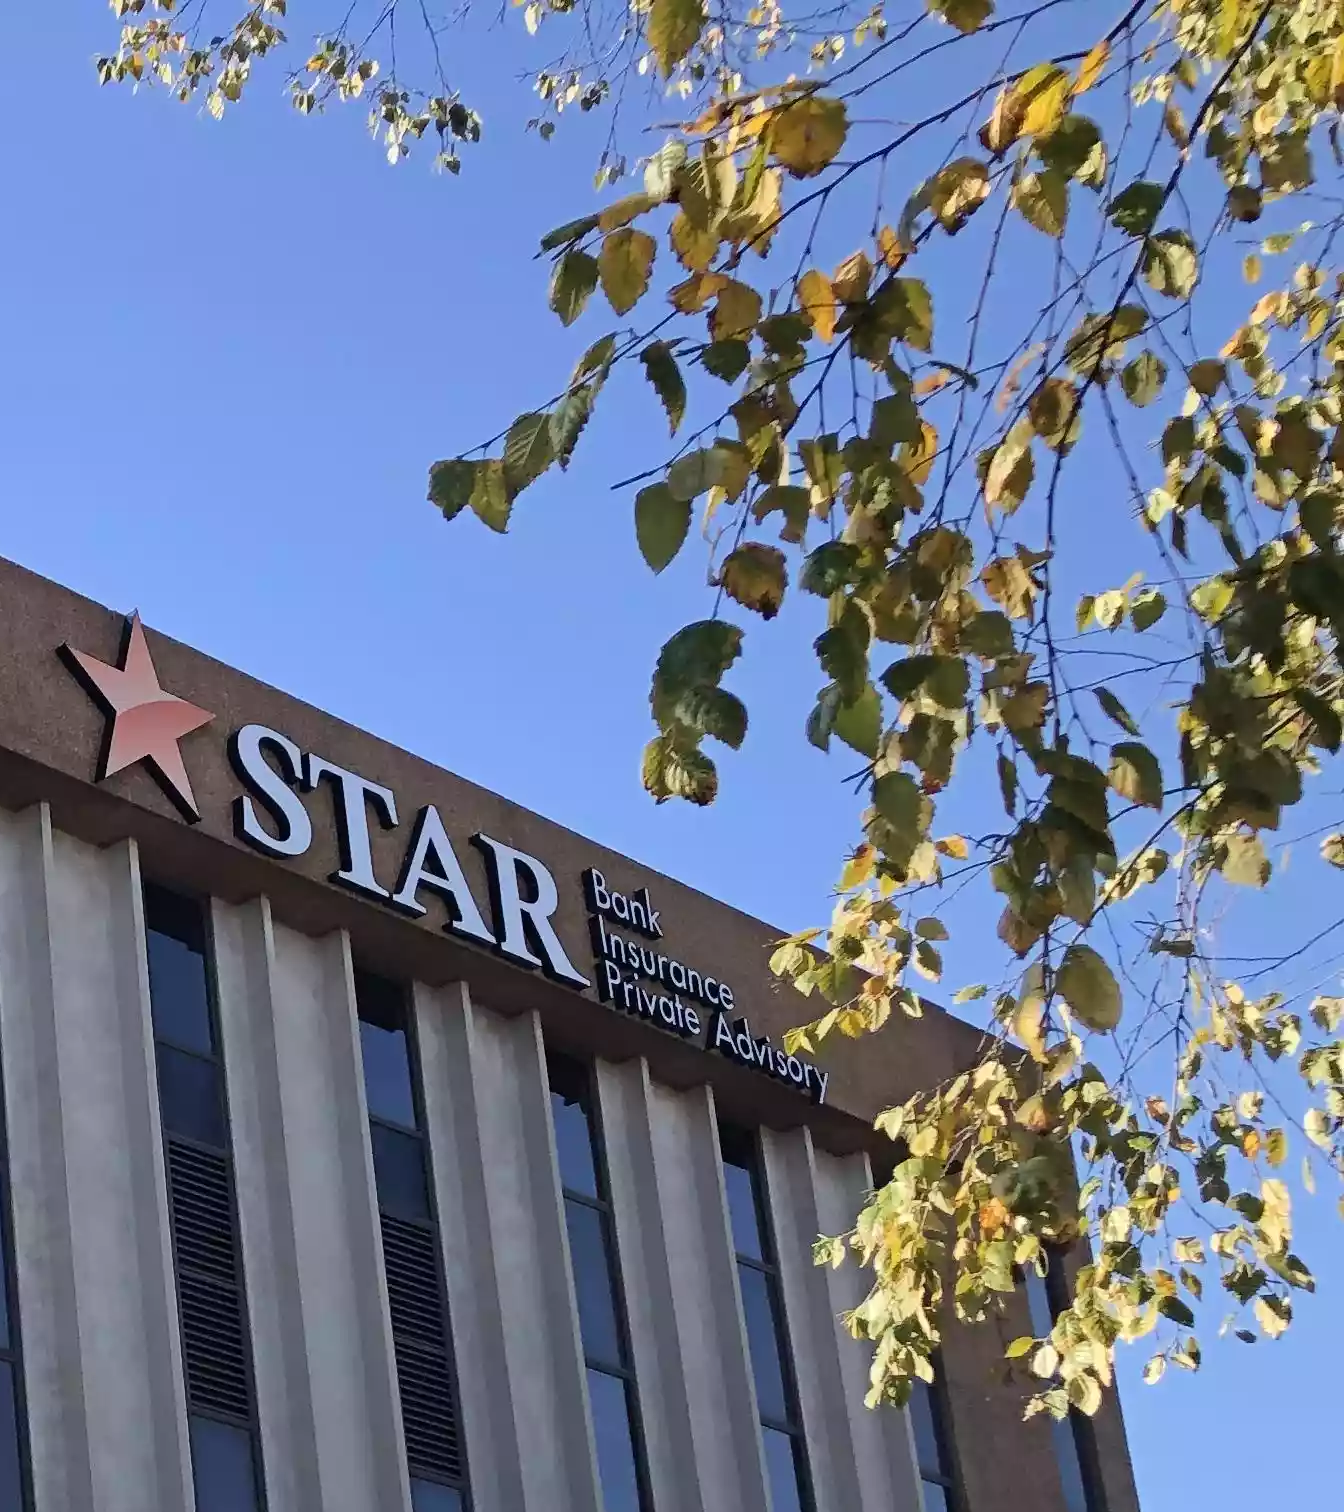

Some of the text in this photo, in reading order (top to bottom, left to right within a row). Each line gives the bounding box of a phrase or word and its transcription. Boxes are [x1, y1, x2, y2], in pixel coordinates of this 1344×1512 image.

[231, 722, 592, 988] STAR
[589, 867, 664, 937] Bank
[596, 914, 735, 1011] Insurance
[603, 958, 829, 1105] Private Advisory
